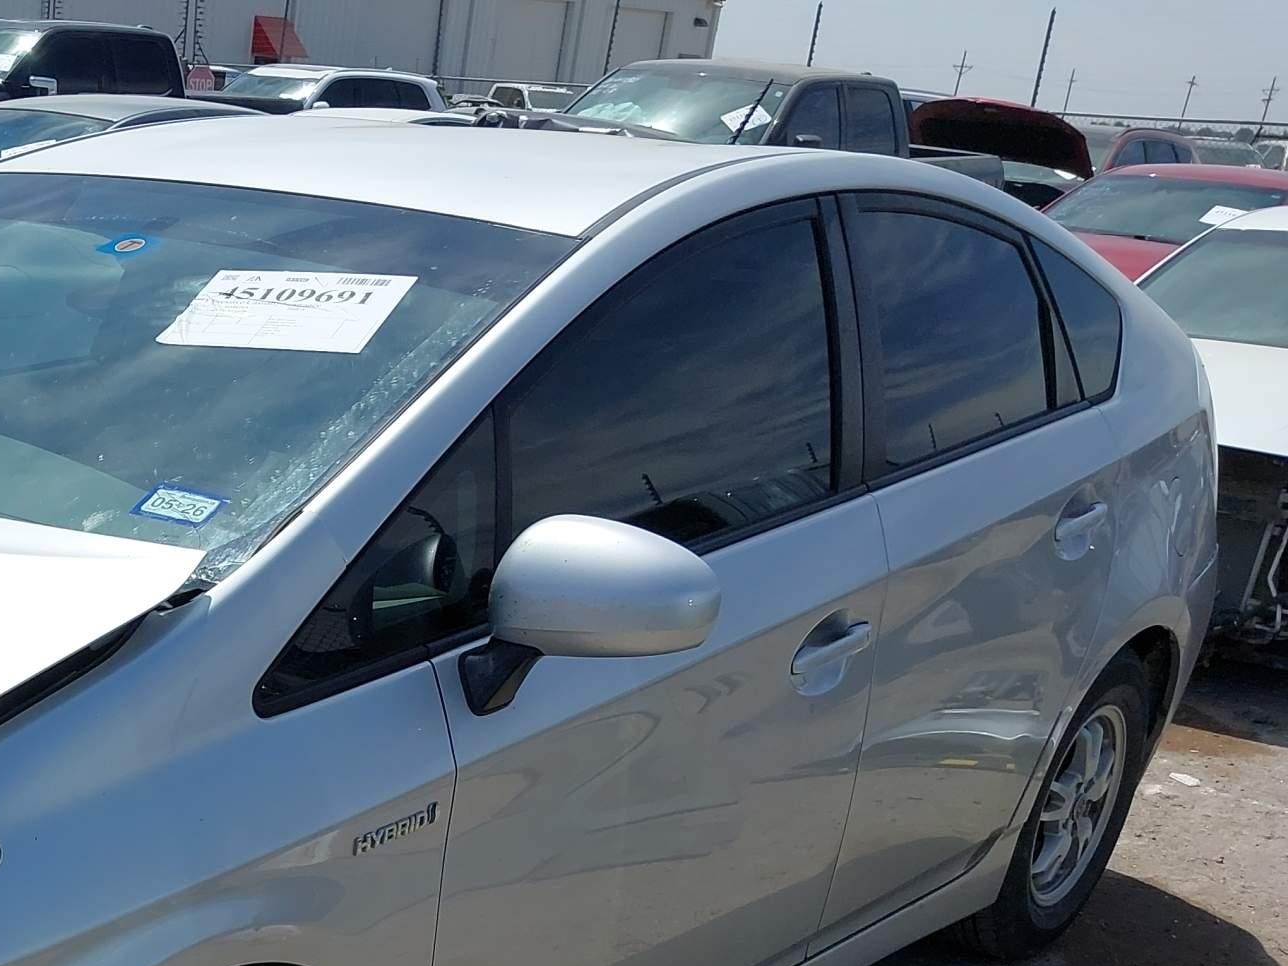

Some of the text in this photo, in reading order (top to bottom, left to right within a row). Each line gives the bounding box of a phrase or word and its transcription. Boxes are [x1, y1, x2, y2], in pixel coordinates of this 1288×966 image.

[190, 78, 212, 91] STOP
[218, 285, 374, 305] 45109691
[352, 801, 439, 856] HYBRID
